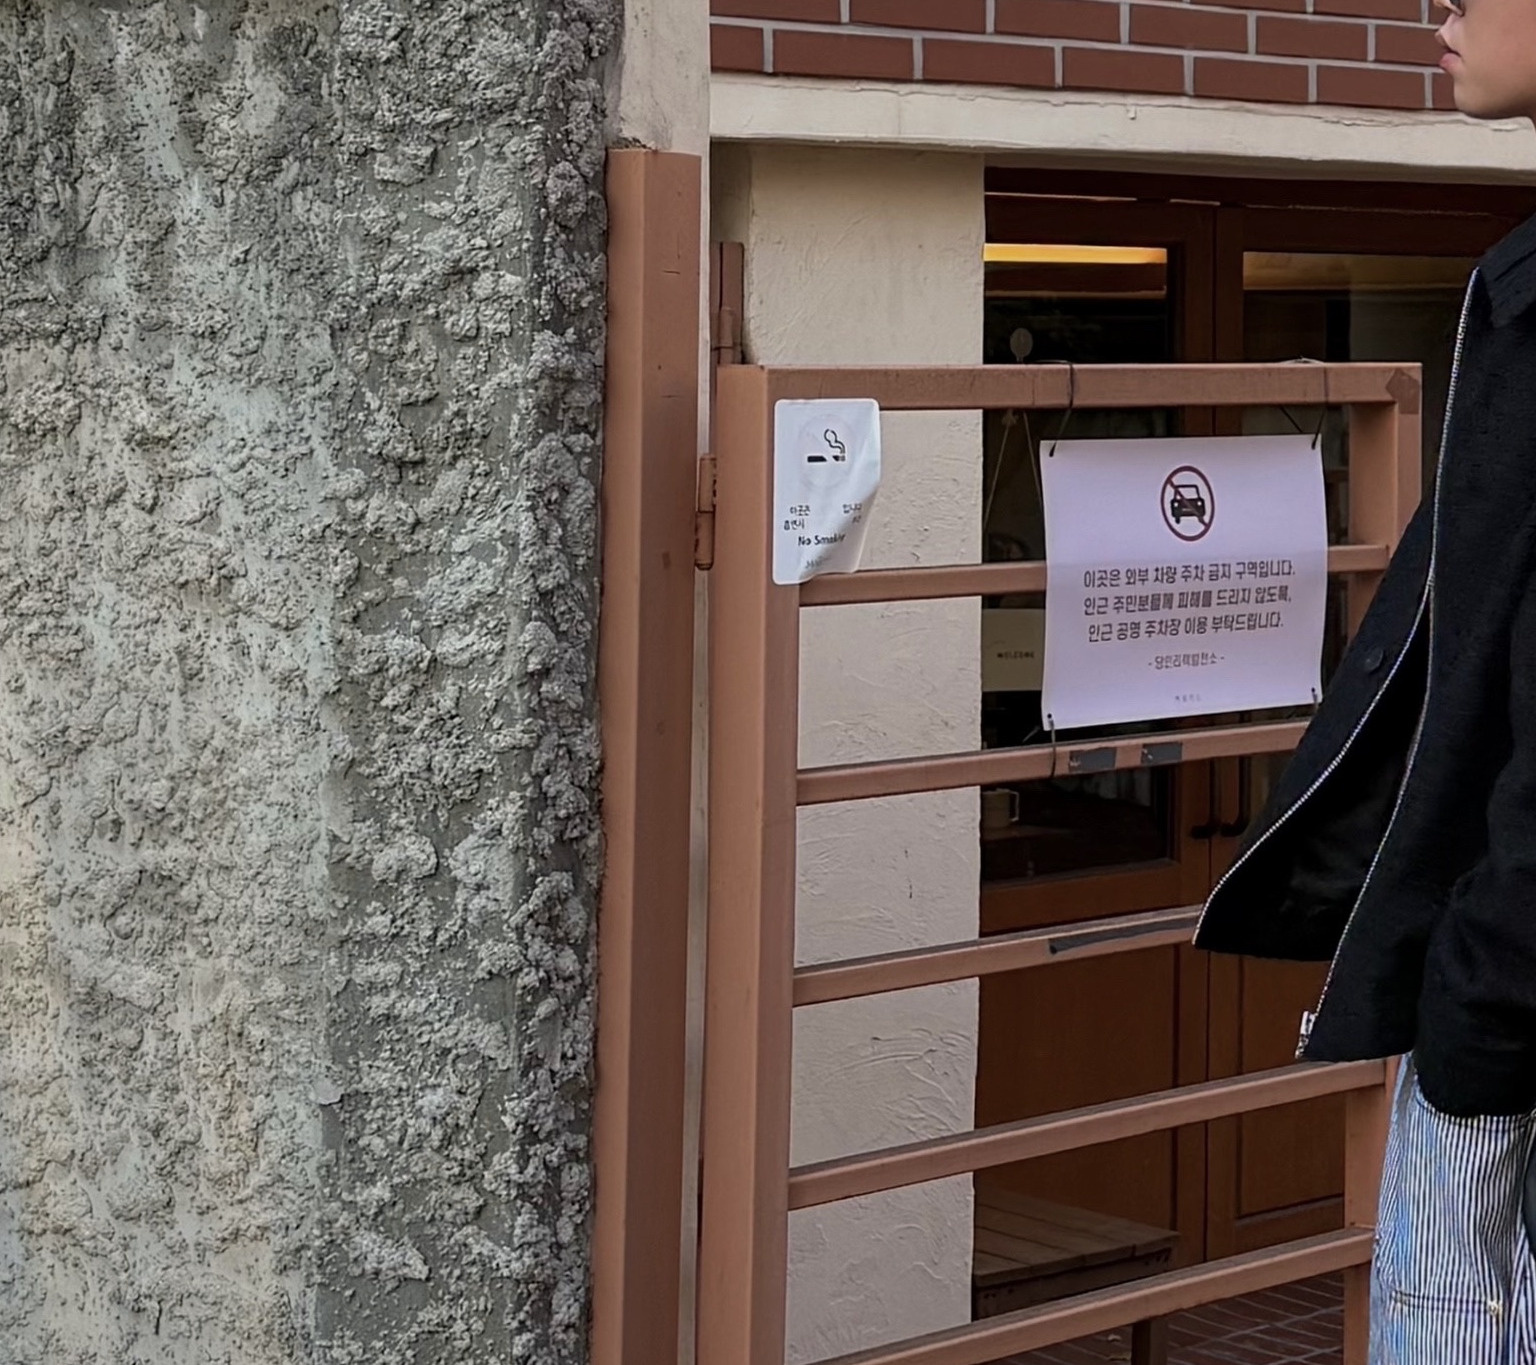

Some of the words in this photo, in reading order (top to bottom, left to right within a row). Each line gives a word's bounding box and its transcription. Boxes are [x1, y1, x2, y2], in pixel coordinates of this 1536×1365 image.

[798, 535, 811, 546] No
[1084, 568, 1121, 588] 이곳은
[1125, 568, 1149, 585] 외부
[1153, 566, 1177, 584] 차량
[1181, 564, 1205, 582] 주차
[1208, 563, 1231, 581] 금지
[1235, 560, 1295, 580] 구역입니다.
[1084, 597, 1108, 615] 인근
[1178, 590, 1212, 608] 피해를
[1217, 588, 1251, 606] 드리지
[1088, 623, 1112, 643] 인근
[1145, 619, 1181, 638] 주차장
[1184, 616, 1208, 635] 이용
[1212, 612, 1283, 632] 부탁드립니다.
